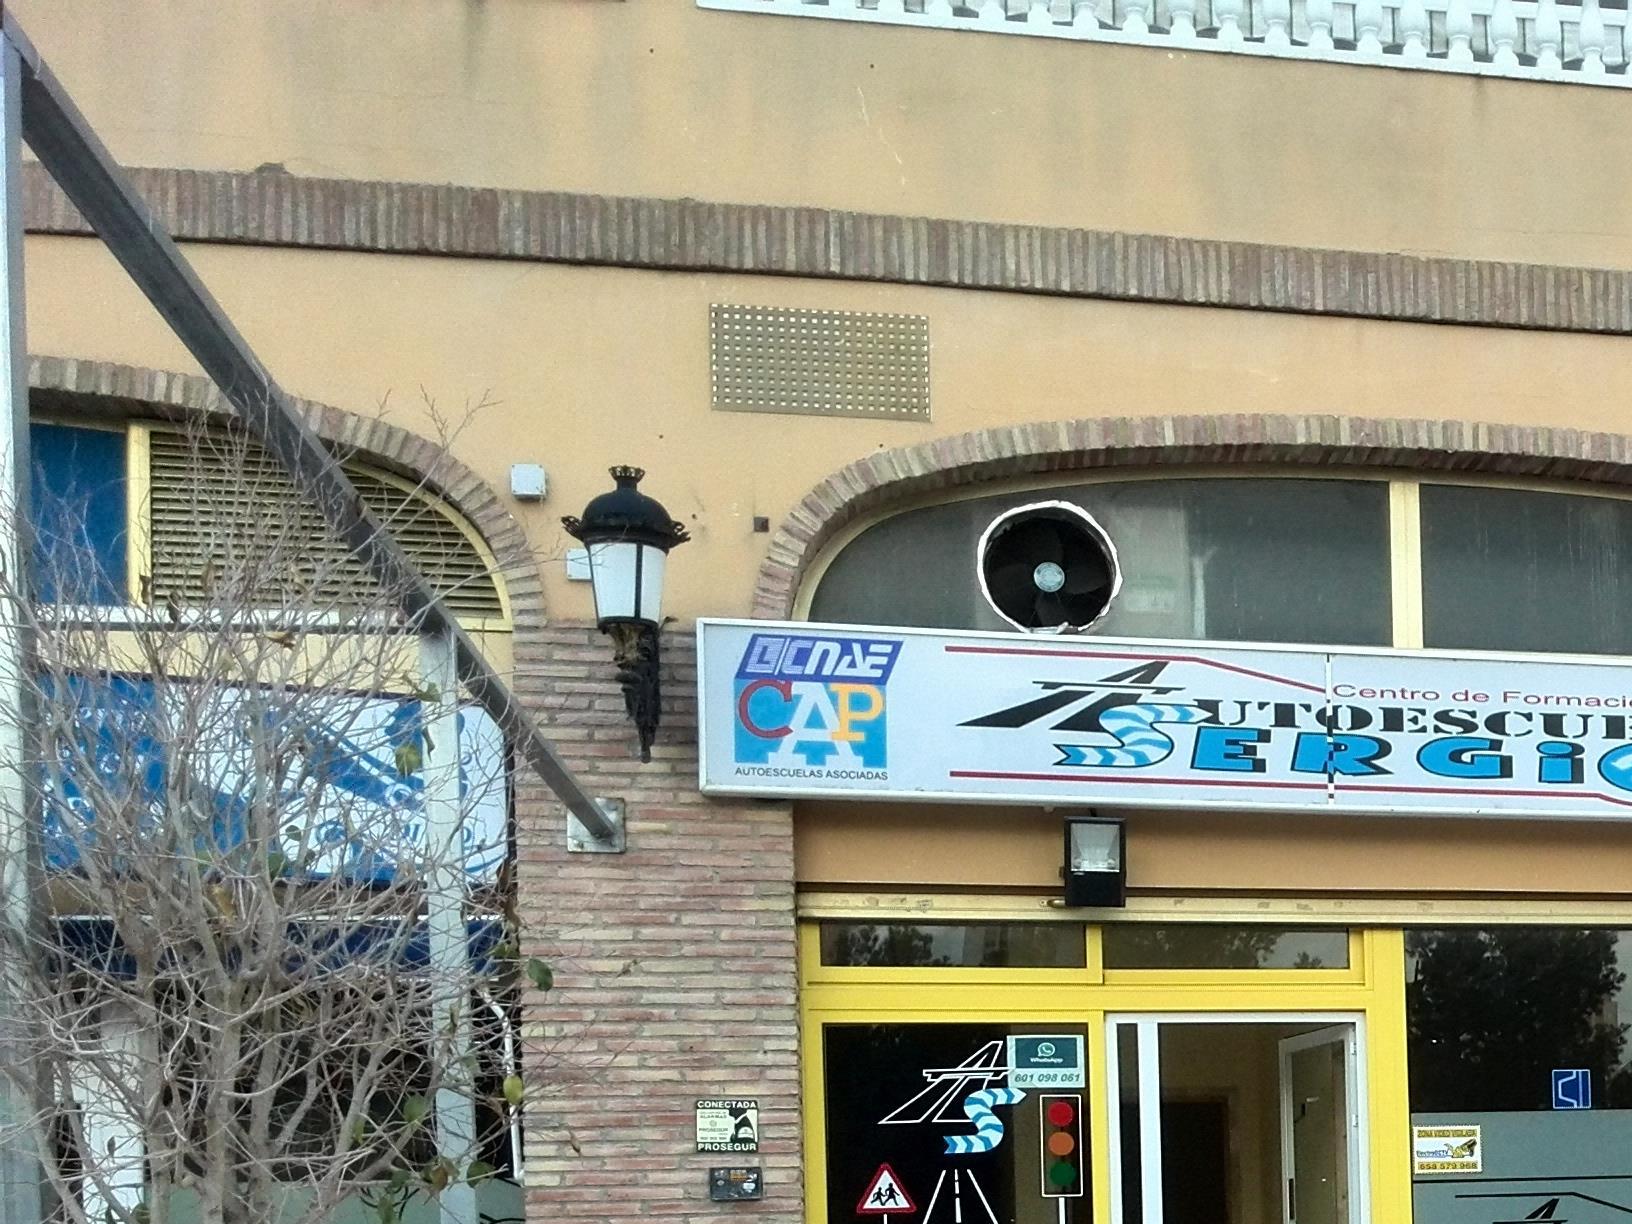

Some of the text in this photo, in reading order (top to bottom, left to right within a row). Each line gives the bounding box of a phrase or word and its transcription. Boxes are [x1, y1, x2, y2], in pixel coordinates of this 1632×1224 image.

[1333, 684, 1440, 701] Centro
[1452, 690, 1489, 703] de
[738, 679, 885, 766] CAP
[735, 767, 888, 781] AUTOESCUELAS ASOCIADAS
[1015, 1073, 1034, 1083] 601
[1038, 1073, 1057, 1082] 098
[697, 1101, 757, 1109] CONECTADA
[698, 1143, 757, 1151] PROSEGUR
